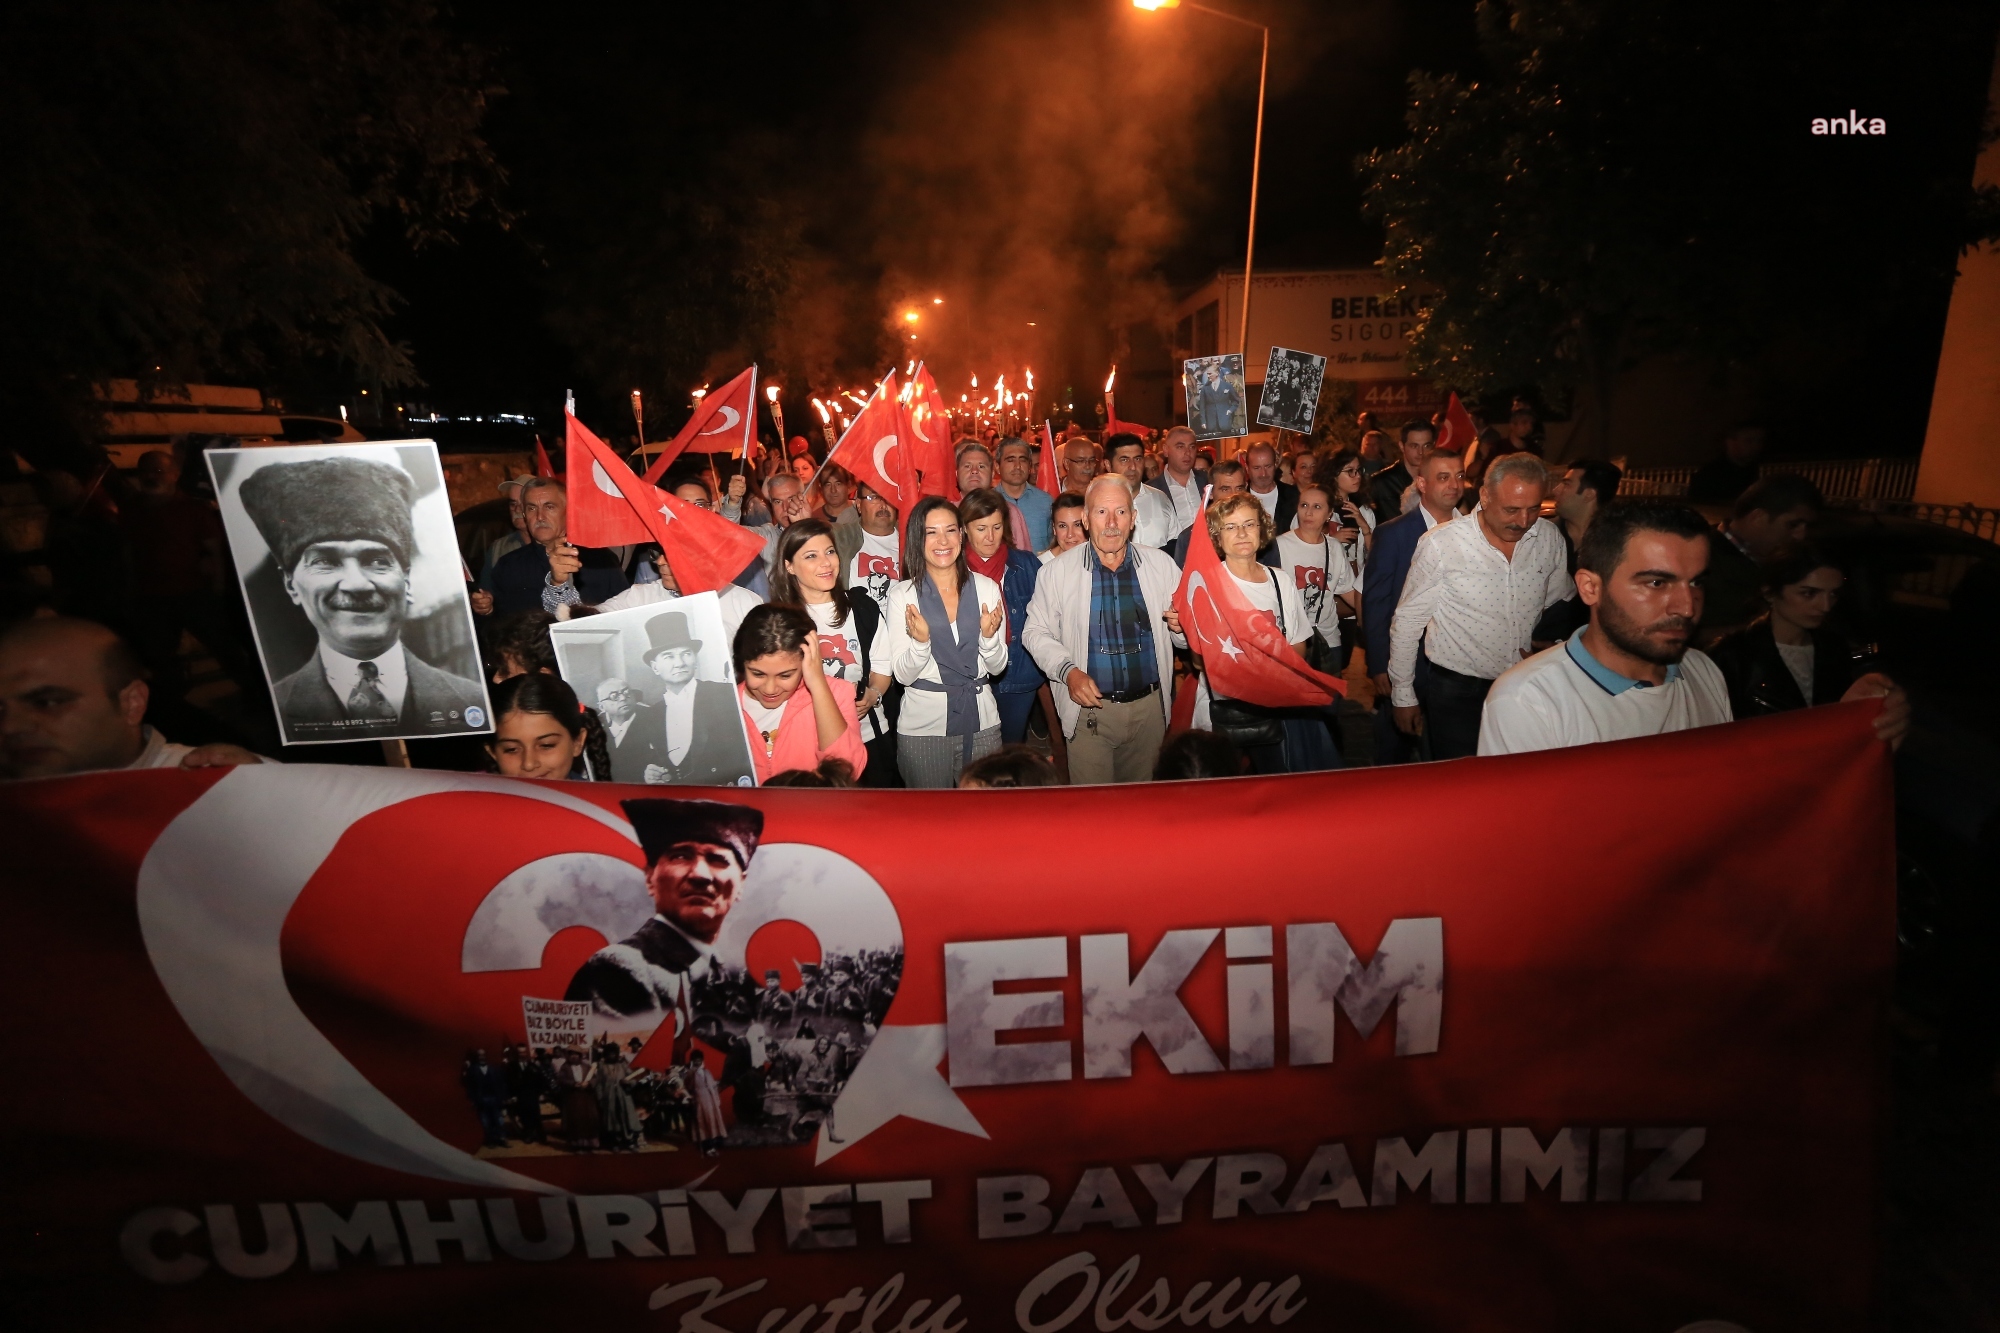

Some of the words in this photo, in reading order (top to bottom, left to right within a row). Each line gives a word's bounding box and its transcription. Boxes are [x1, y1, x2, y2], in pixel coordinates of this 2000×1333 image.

[1364, 385, 1410, 404] 444
[530, 1031, 588, 1045] KAZANDIK
[944, 917, 1444, 1088] EKİM
[118, 1178, 933, 1285] CUMHURİYET
[977, 1126, 1707, 1241] BAYRAMIMIZ
[648, 1271, 969, 1333] Kutlu
[1014, 1250, 1308, 1333] Olsun
